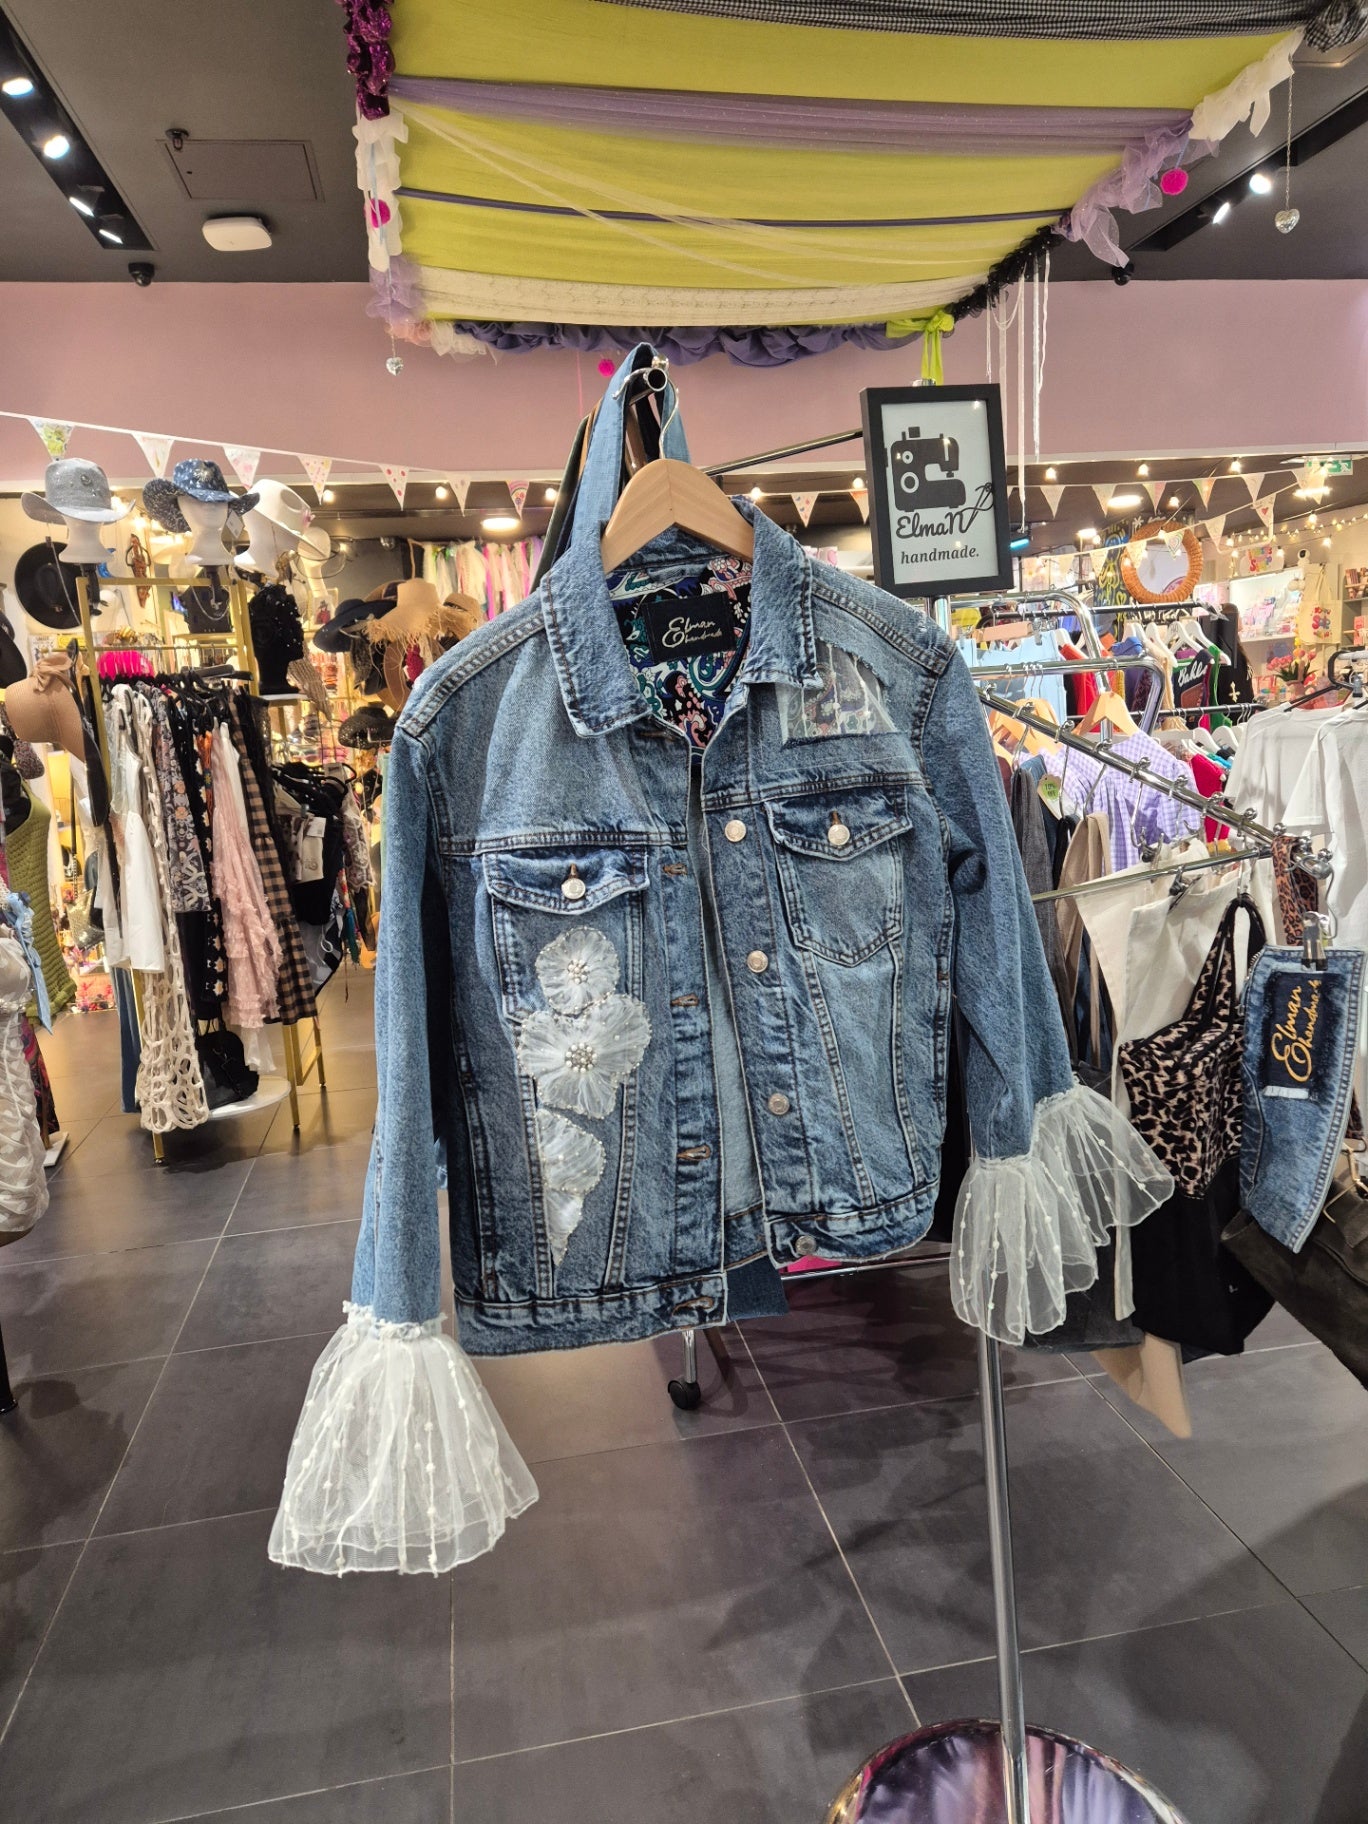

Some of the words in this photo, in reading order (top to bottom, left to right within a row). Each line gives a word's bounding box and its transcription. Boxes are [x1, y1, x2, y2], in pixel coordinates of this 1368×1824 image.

[901, 545, 979, 564] handmade.
[662, 616, 716, 648] Elman
[1270, 986, 1312, 1082] Elman
